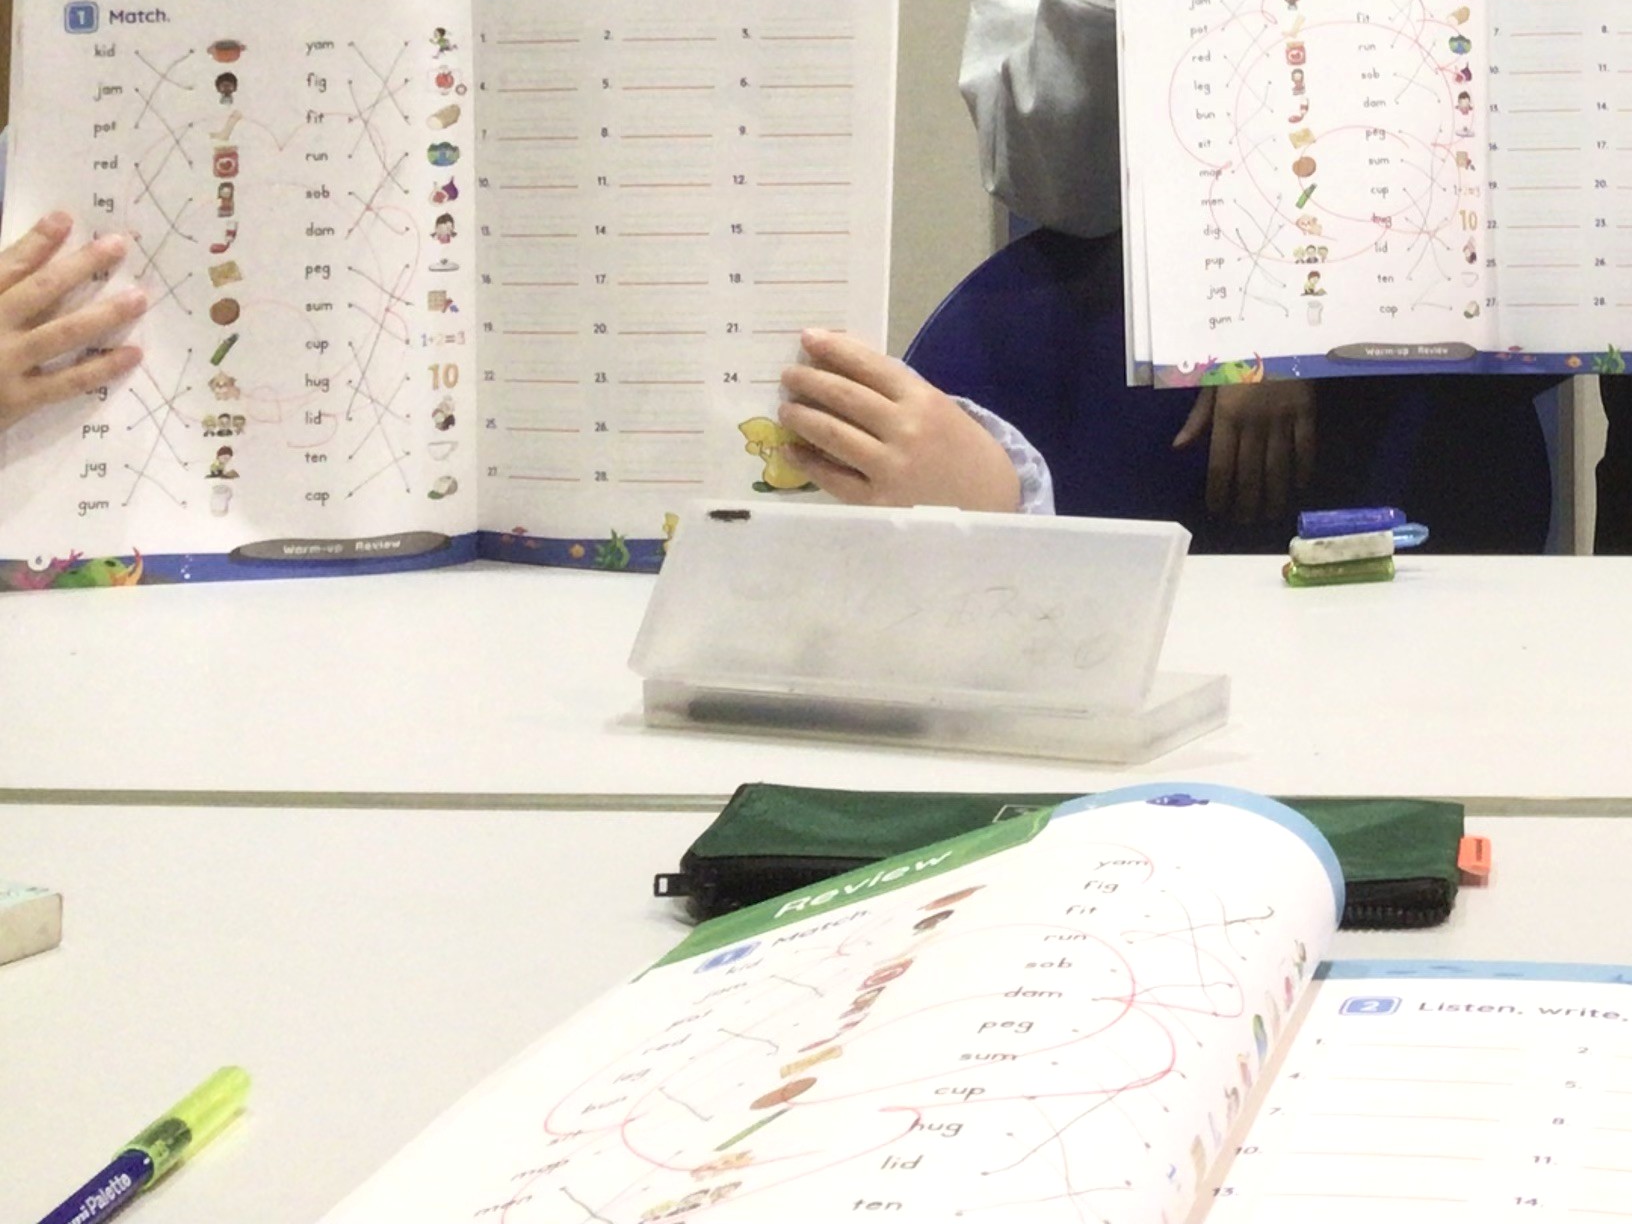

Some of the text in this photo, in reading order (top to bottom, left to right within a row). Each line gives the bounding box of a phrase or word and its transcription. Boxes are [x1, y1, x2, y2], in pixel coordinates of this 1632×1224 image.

[108, 7, 171, 25] Match.
[1356, 13, 1370, 24] fit
[1190, 24, 1208, 39] pot
[94, 43, 116, 58] kid
[305, 39, 335, 56] yam
[1358, 42, 1376, 51] run
[1192, 52, 1211, 62] red
[305, 74, 327, 93] fig
[1193, 80, 1211, 95] leg
[94, 83, 123, 101] jam
[1363, 97, 1386, 107] dam
[305, 111, 325, 125] fit
[1196, 109, 1216, 120] bun
[93, 121, 117, 138] pot
[1365, 128, 1386, 141] peg
[93, 156, 118, 170] red
[305, 151, 328, 162] run
[305, 186, 330, 200] sob
[1370, 185, 1389, 198] cup
[93, 194, 114, 212] leg
[305, 223, 335, 237] dam
[1203, 225, 1221, 239] dig
[1374, 241, 1388, 253] lid
[1205, 256, 1225, 269] pup
[305, 264, 331, 279] peg
[1378, 274, 1394, 284] ten
[1207, 284, 1227, 299] jug
[305, 301, 333, 312] sum
[1379, 305, 1398, 317] cap
[1208, 315, 1232, 329] gum
[305, 338, 330, 355] cup
[305, 374, 330, 393] hug
[427, 363, 459, 390] 10
[305, 411, 323, 425] lid
[82, 422, 109, 439] pup
[305, 451, 327, 463] ten
[79, 460, 107, 478] jug
[305, 490, 330, 506] cap
[77, 499, 109, 516] gum
[355, 539, 402, 552] Review
[774, 851, 952, 919] Review
[1083, 880, 1119, 894] fig
[1065, 905, 1098, 915] fit
[1043, 933, 1088, 942] run
[1004, 986, 1063, 999] dam
[1417, 1002, 1524, 1015] Listen,
[1538, 1006, 1629, 1022] write,
[977, 1019, 1035, 1034] peg
[958, 1052, 1019, 1061] sum
[933, 1085, 986, 1100] cup
[880, 1155, 924, 1170] lid
[851, 1198, 903, 1211] ten
